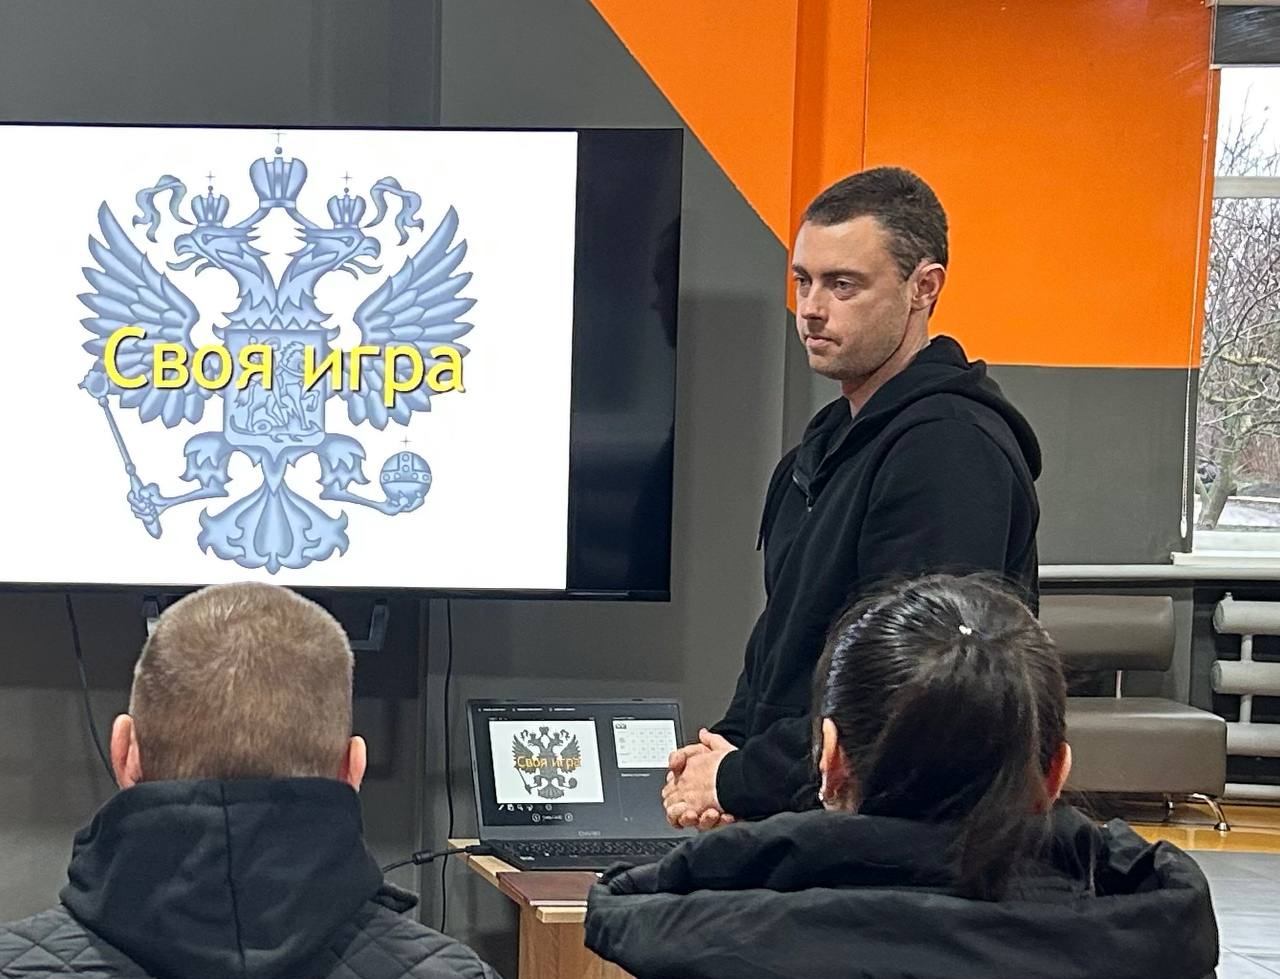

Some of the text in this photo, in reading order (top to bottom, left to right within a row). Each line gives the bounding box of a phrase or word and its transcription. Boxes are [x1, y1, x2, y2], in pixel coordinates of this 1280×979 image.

[103, 325, 467, 409] Своя игра
[517, 756, 582, 770] Своя игра
